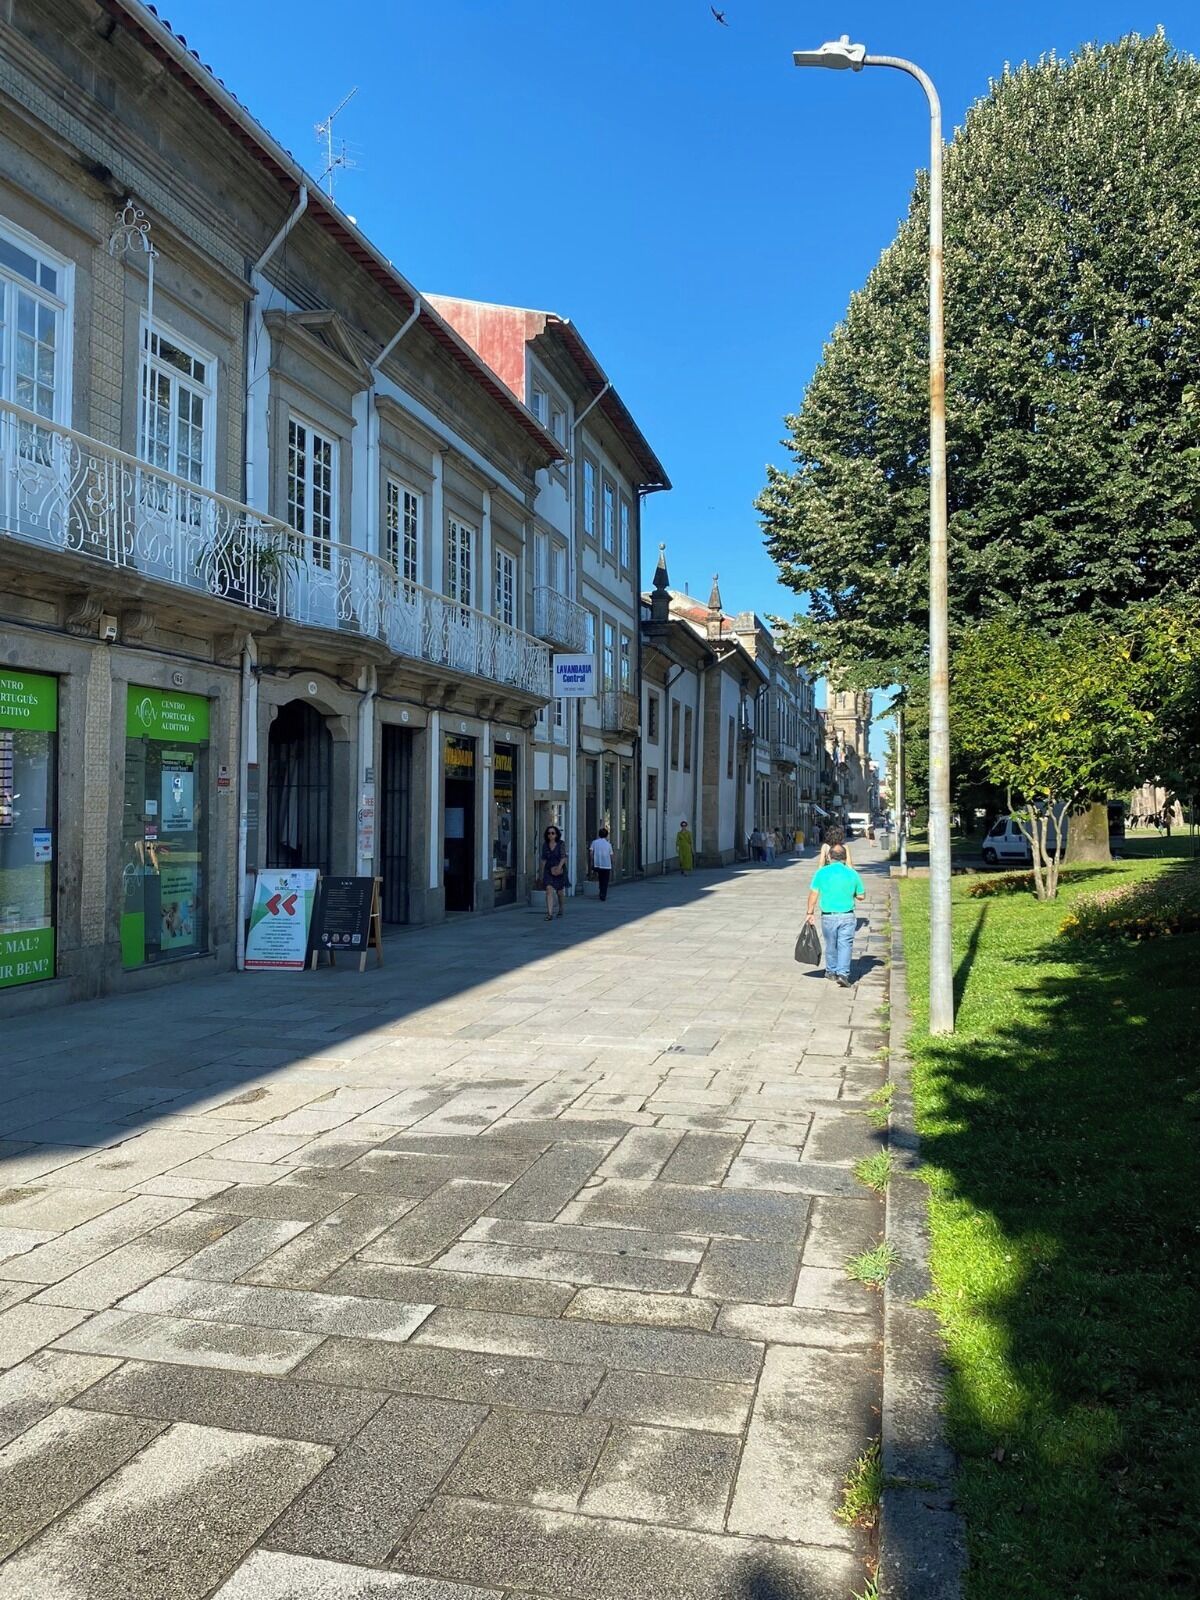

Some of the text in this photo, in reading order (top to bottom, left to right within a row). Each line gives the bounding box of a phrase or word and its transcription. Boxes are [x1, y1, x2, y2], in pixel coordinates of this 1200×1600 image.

[556, 664, 592, 674] LAVANDARIA
[562, 673, 586, 683] Central
[161, 700, 186, 711] CENTRO
[161, 711, 196, 723] PORTUGUÊS
[161, 722, 190, 733] AUDITIVO
[6, 936, 40, 954] MAL?
[17, 958, 49, 976] BEM?
